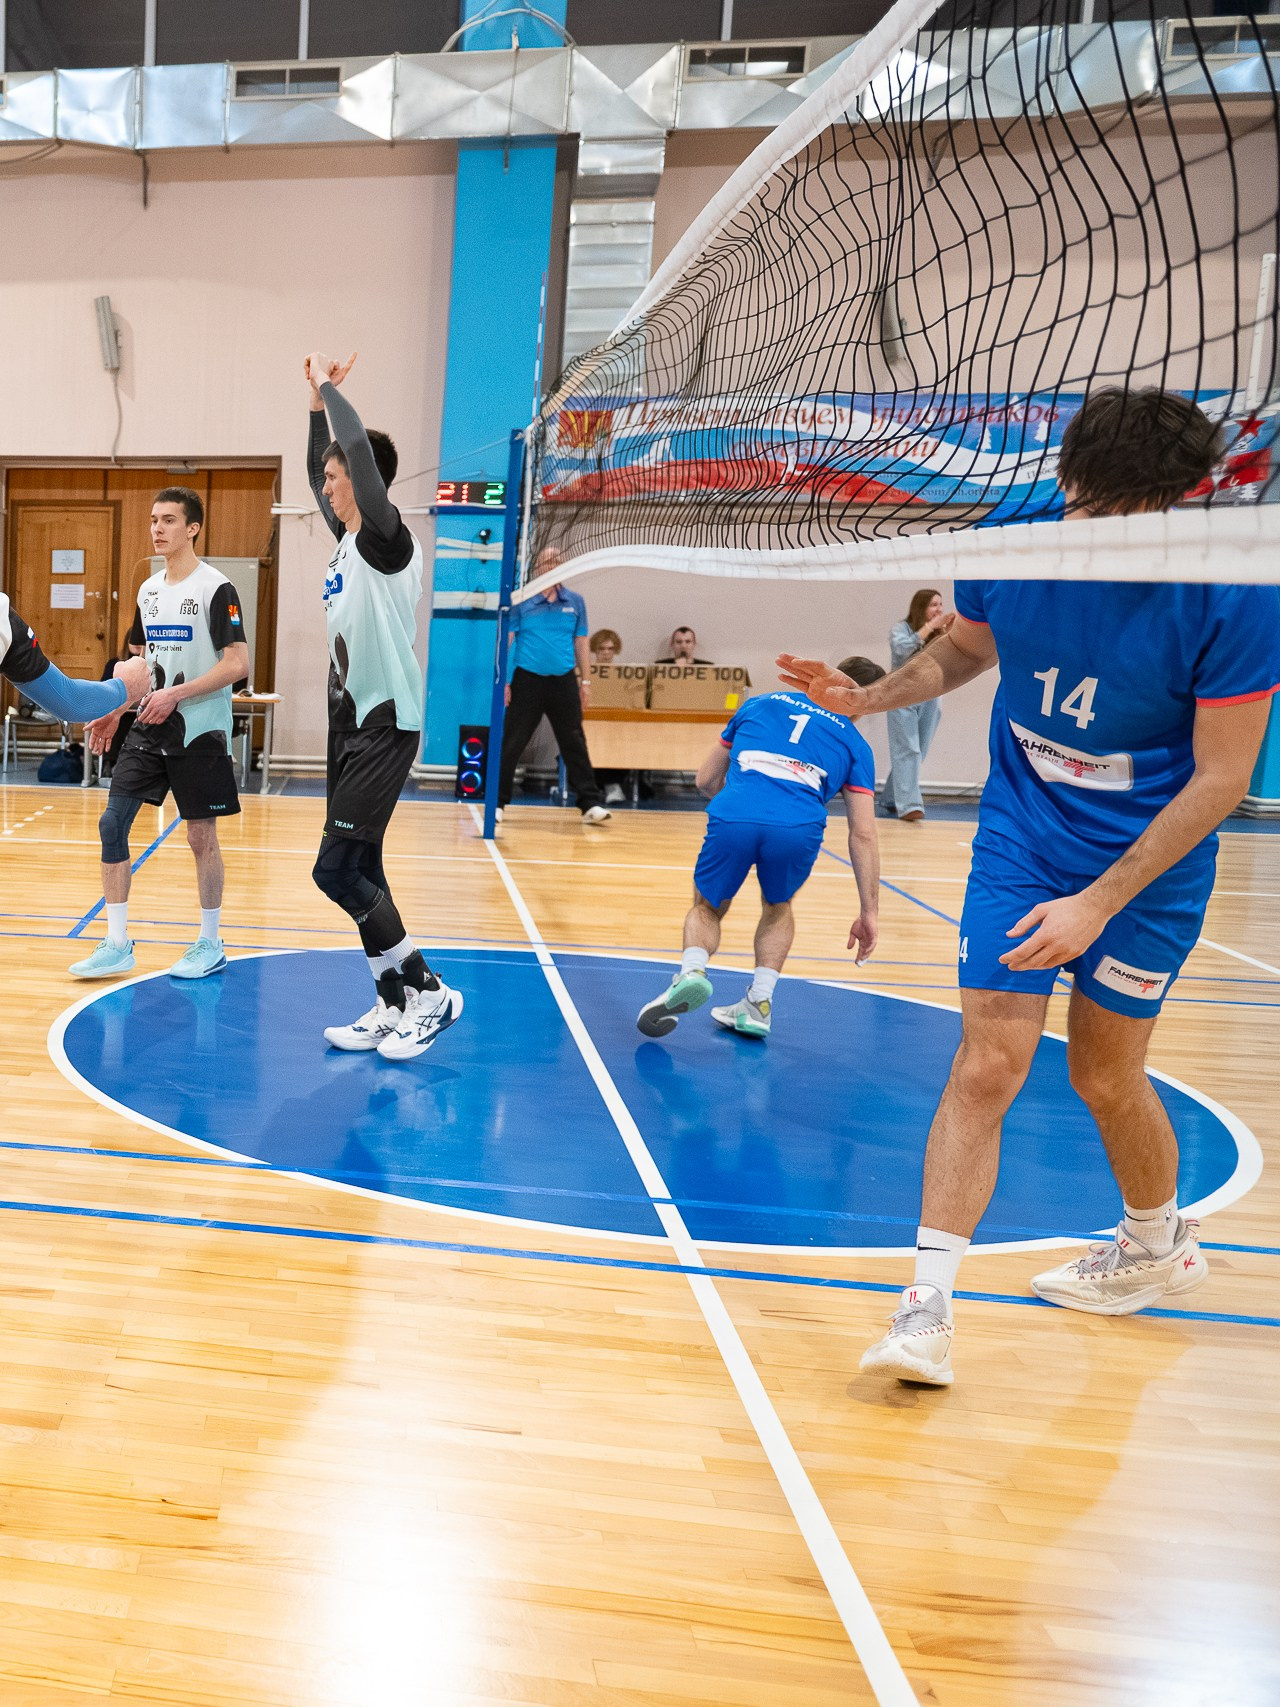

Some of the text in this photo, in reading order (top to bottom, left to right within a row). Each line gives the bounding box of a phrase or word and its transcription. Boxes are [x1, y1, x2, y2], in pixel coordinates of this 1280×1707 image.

[435, 482, 504, 505] 21 2
[616, 665, 647, 680] 100
[654, 665, 745, 681] HOPE 100
[1034, 667, 1098, 730] 14
[788, 714, 812, 745] 1
[1018, 737, 1111, 769] AHRENHEIT
[334, 819, 354, 830] TEAM
[959, 936, 969, 963] 4
